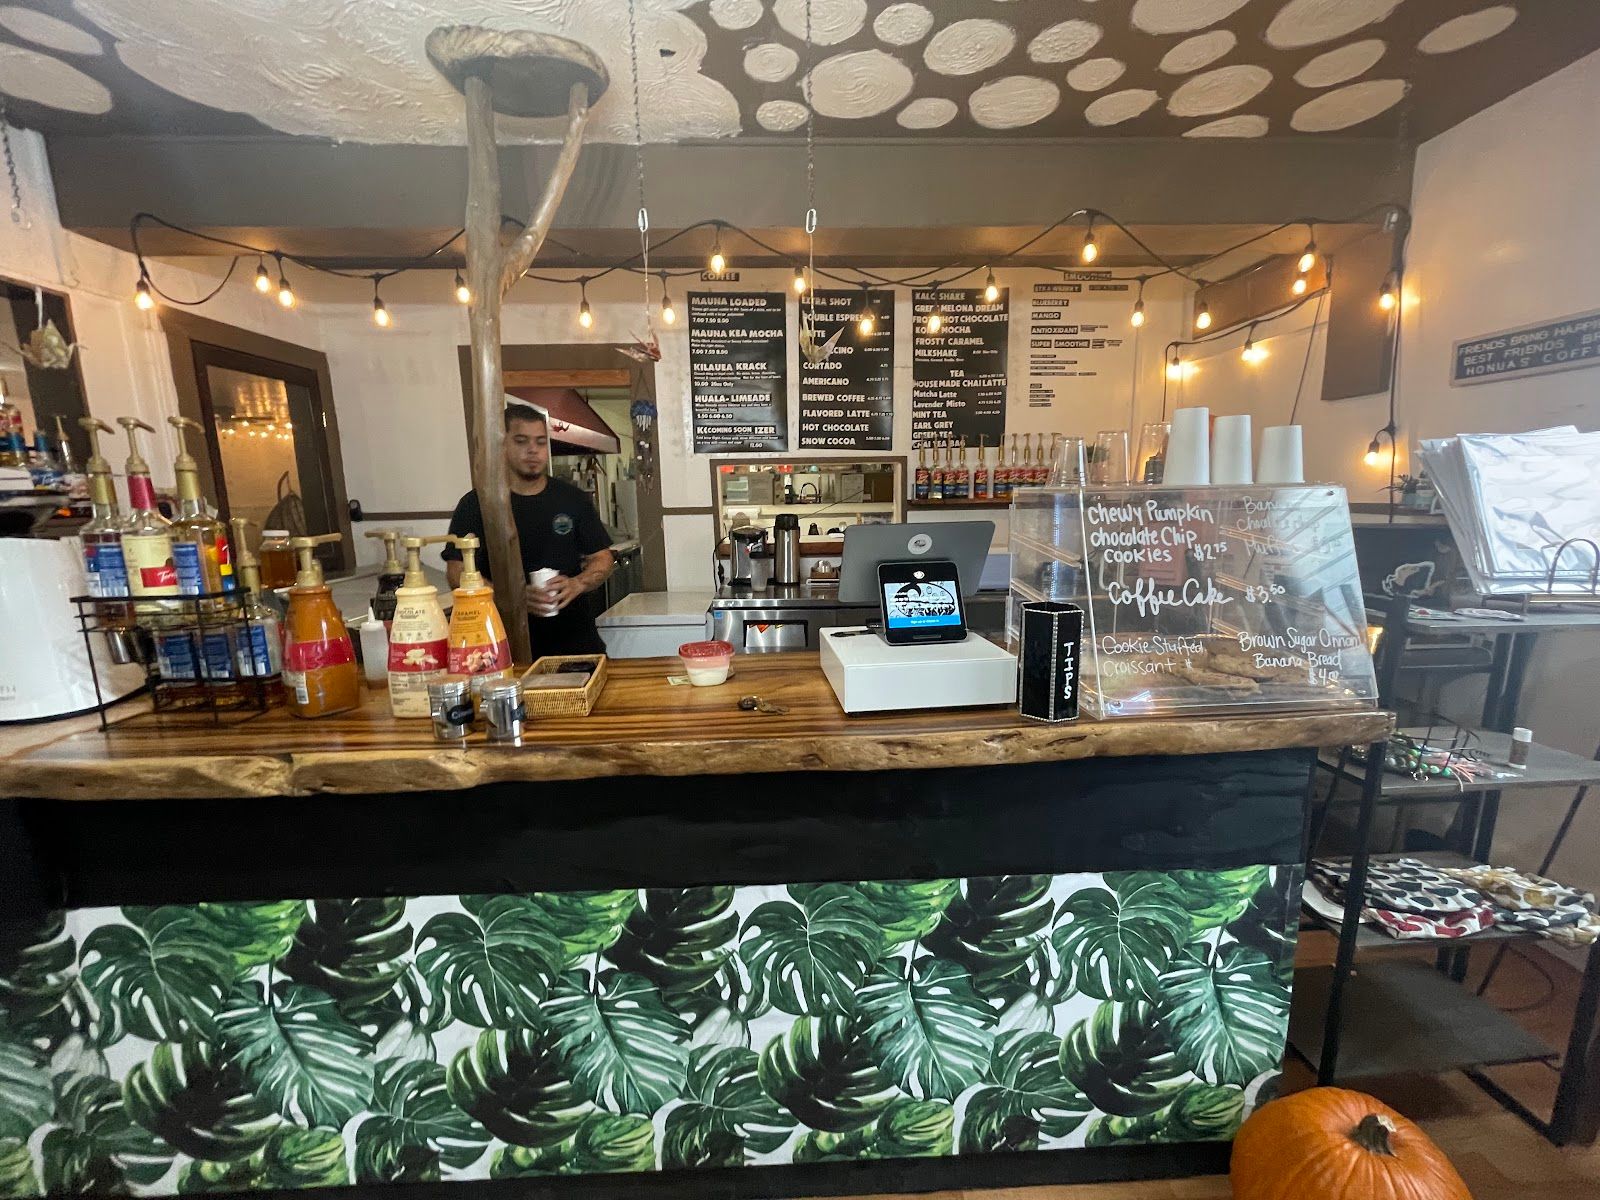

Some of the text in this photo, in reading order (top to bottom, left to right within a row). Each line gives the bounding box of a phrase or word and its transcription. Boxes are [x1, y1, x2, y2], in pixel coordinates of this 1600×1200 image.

[702, 272, 736, 280] COFFEE
[692, 297, 767, 306] MAUNA LOADED
[830, 298, 852, 306] SHOT
[940, 304, 974, 312] MELONA
[975, 304, 1004, 312] DREAM
[836, 314, 876, 322] ESPRESO
[960, 314, 1008, 323] CHOCOLATE
[692, 329, 784, 338] MAUNA KEA MOCHA
[948, 338, 984, 346] CARAMEL
[1032, 340, 1051, 348] SUPER
[1055, 340, 1090, 348] SMOOTHIE
[914, 348, 958, 356] MILKSHAKE
[1464, 352, 1494, 366] BEST
[1504, 339, 1566, 358] FRIENDS
[694, 362, 767, 371] KILAUEA KRACK
[802, 362, 842, 370] CORTADO
[950, 370, 964, 378] TEA
[802, 378, 850, 386] AMERICANO
[982, 378, 1006, 386] LATTE
[802, 394, 834, 402] BREWED
[802, 410, 844, 418] FLAVORED
[846, 410, 870, 418] LATTE
[912, 410, 931, 418] MINT
[802, 423, 869, 432] HOT CHOCOLATE
[914, 422, 932, 430] EARL
[1146, 500, 1214, 526] Pumpkin
[1160, 526, 1198, 549] Chip
[1108, 577, 1183, 617] Coffee
[1182, 577, 1234, 607] Cake
[1237, 632, 1286, 652] Brown
[1286, 627, 1317, 653] Sugar
[1102, 635, 1204, 656] Cookie Stuffed
[1252, 649, 1342, 670] Banana Bread
[1063, 642, 1075, 700] TIPS
[1103, 658, 1176, 677] Croissant
